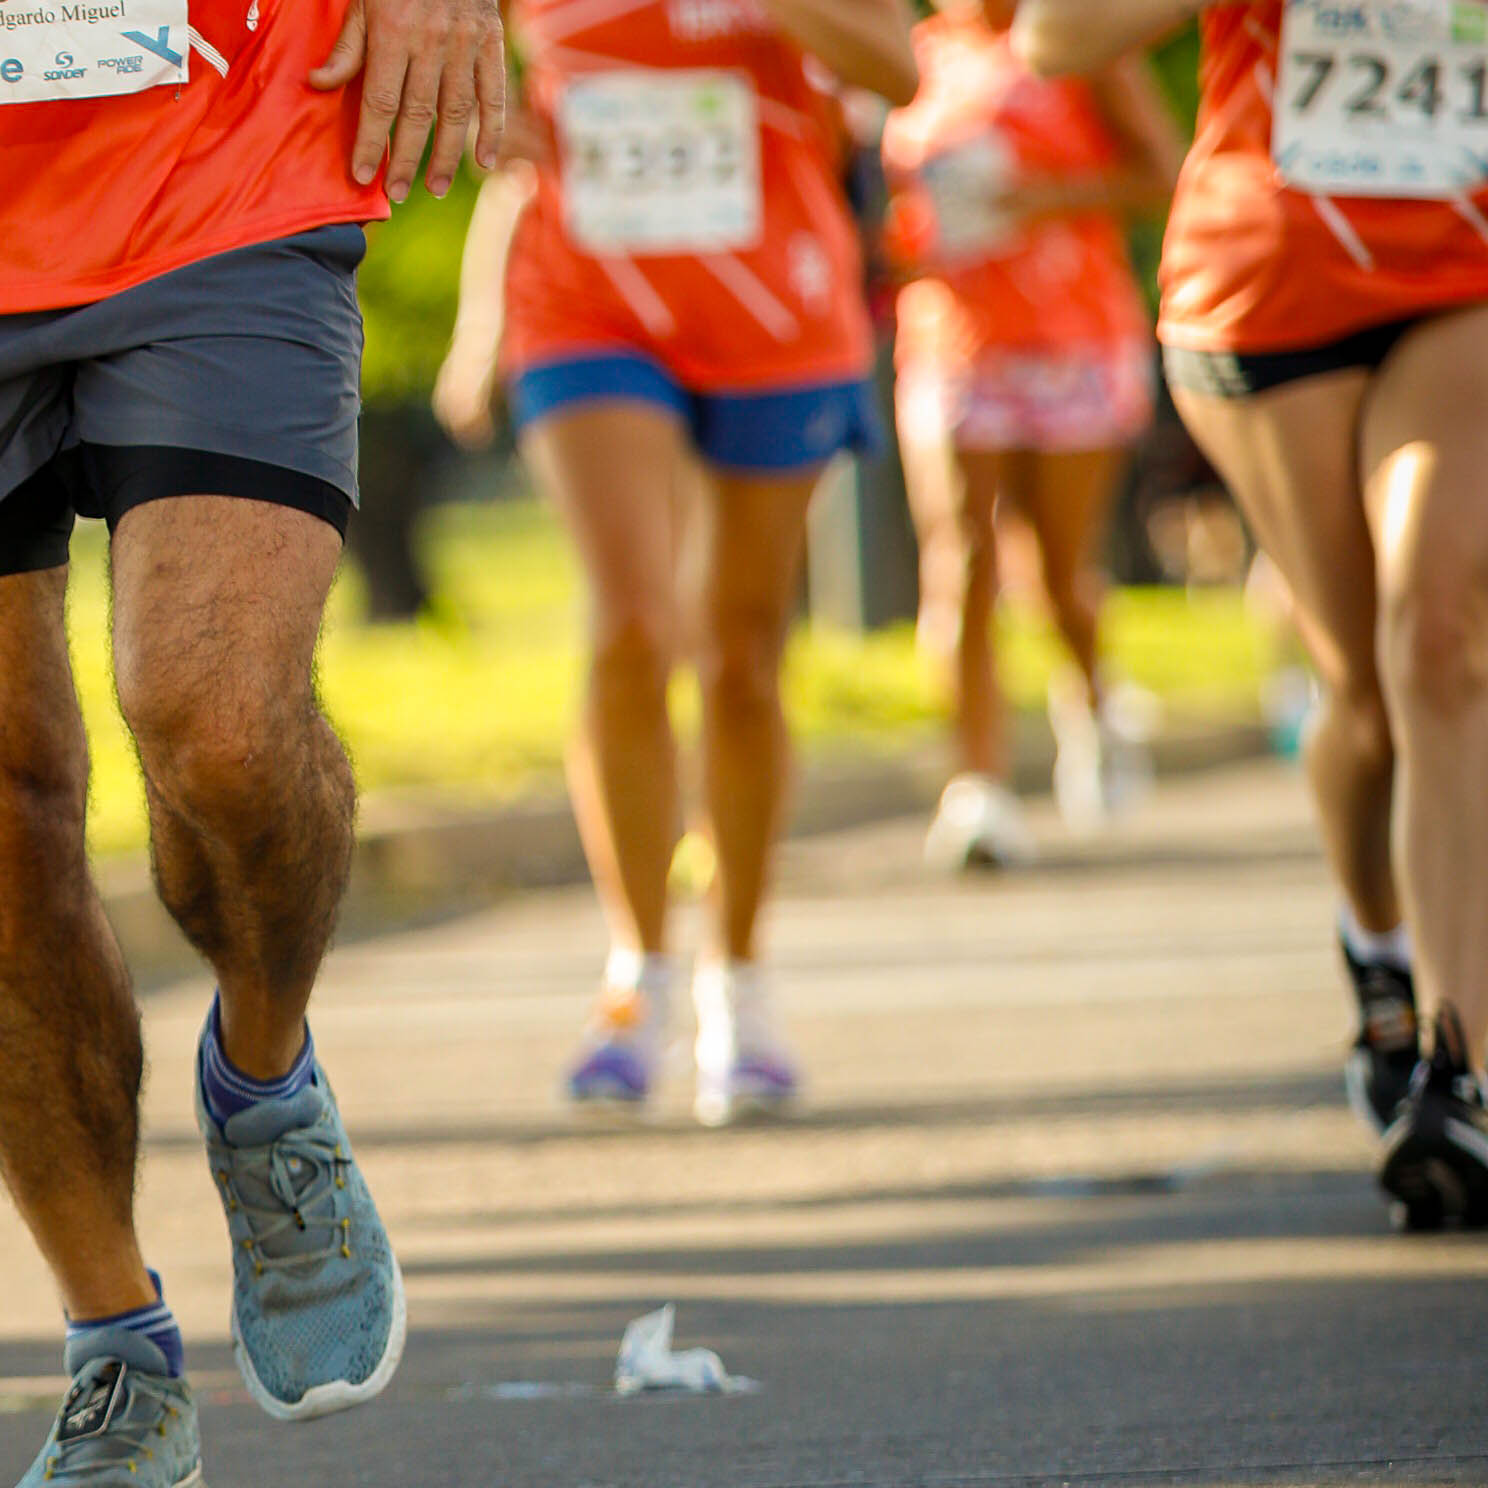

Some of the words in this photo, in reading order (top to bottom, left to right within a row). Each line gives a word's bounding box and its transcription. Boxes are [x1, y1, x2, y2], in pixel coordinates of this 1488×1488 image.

[61, 0, 126, 24] Miguel
[97, 55, 143, 69] POWER
[1292, 51, 1488, 123] 7241
